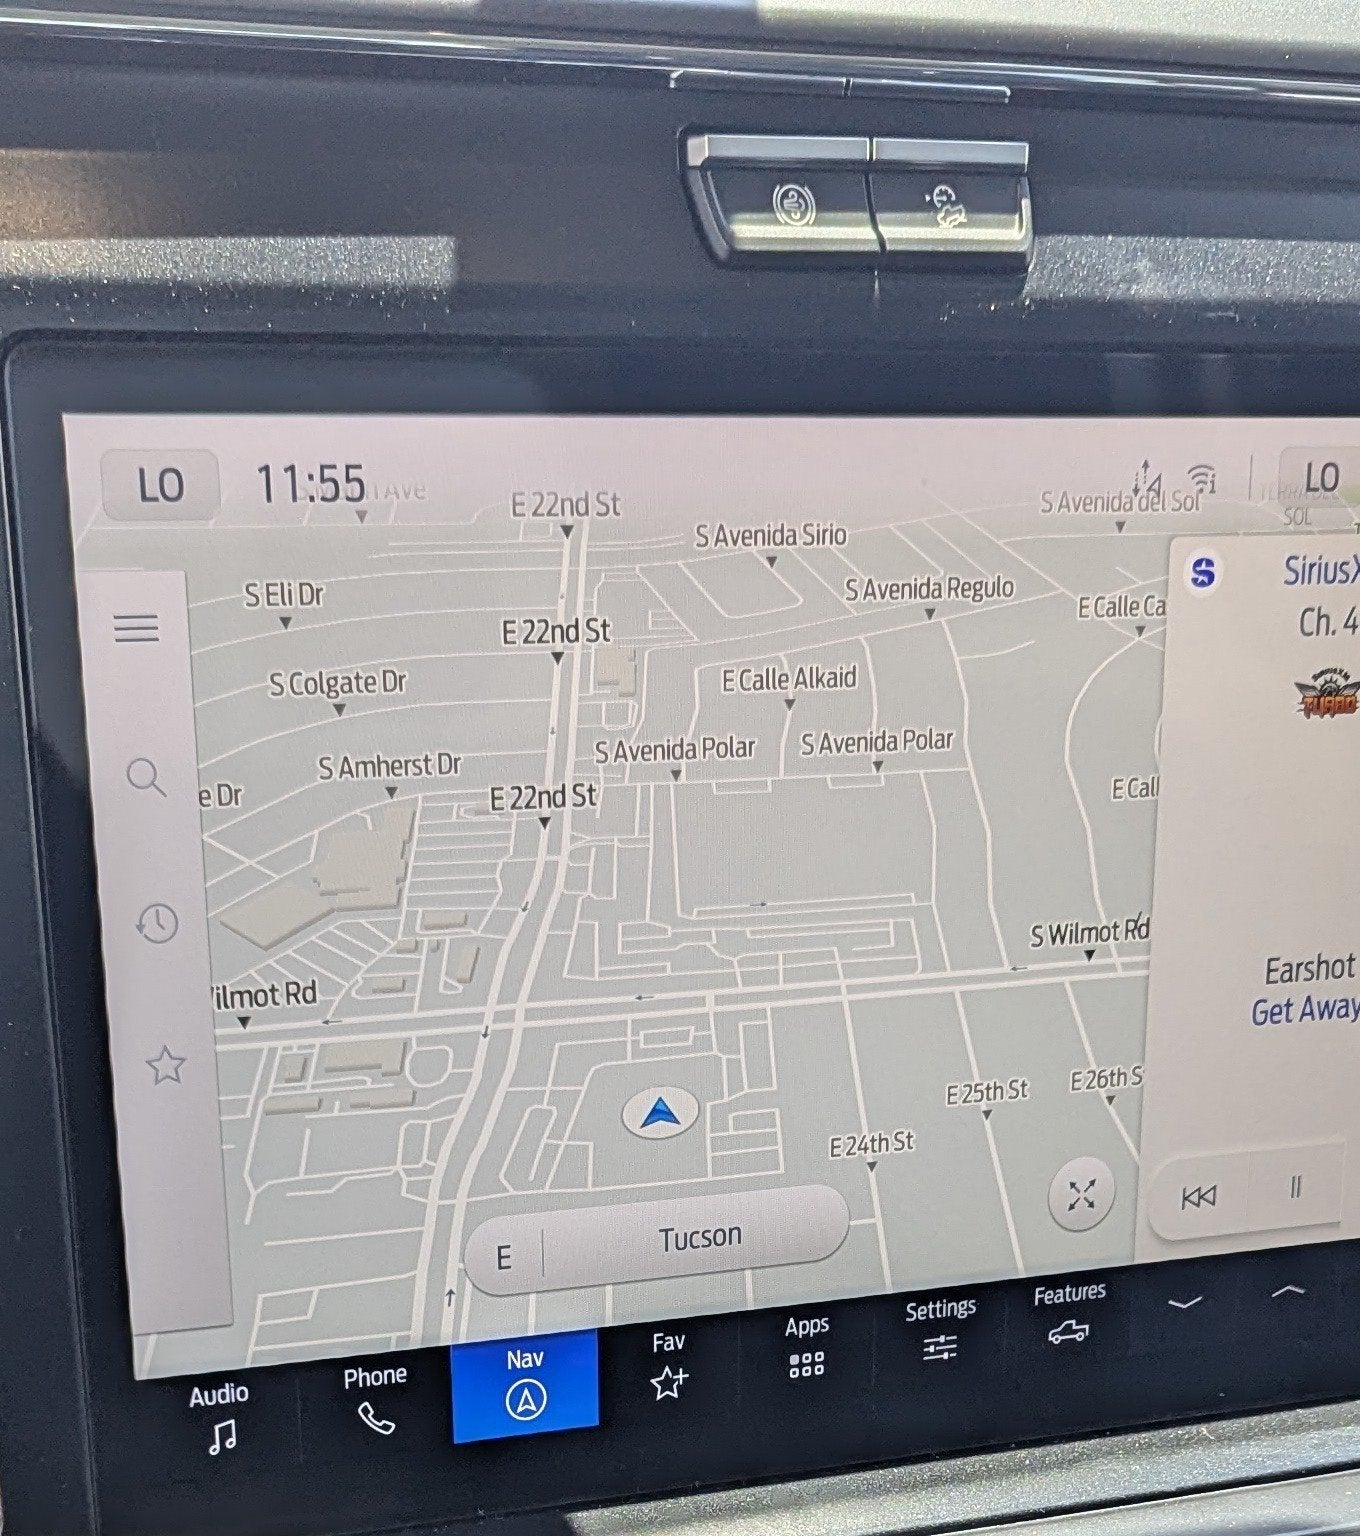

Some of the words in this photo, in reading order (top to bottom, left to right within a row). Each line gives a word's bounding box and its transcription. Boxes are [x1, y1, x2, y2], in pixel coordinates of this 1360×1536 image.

[138, 467, 185, 503] LO
[257, 463, 366, 504] 11:55
[1306, 462, 1340, 492] LO
[511, 492, 527, 517] E
[531, 489, 589, 517] 22nd
[594, 489, 621, 516] St
[1041, 491, 1054, 513] S
[1057, 490, 1133, 513] Avenida
[1139, 491, 1166, 512] del
[1172, 490, 1200, 512] Sol
[695, 524, 709, 548] S
[713, 524, 797, 547] Avenida
[801, 523, 847, 546] Sirio
[244, 584, 259, 607] S
[264, 582, 296, 607] Eli
[299, 583, 325, 606] Dr
[845, 579, 859, 602] S
[863, 577, 942, 601] Avenida
[947, 576, 1014, 602] Regulo
[1079, 597, 1090, 618] E
[1094, 595, 1140, 618] Calle
[503, 620, 517, 644] E
[520, 618, 579, 645] 22nd
[583, 618, 611, 643] St
[1300, 606, 1336, 637] Ch.
[269, 673, 284, 697] S
[289, 670, 377, 701] Colgate
[381, 670, 407, 693] Dr
[723, 669, 735, 692] E
[739, 668, 789, 691] Calle
[794, 666, 857, 689] Alkaid
[595, 740, 609, 764] S
[612, 737, 697, 763] Avenida
[701, 736, 755, 761] Polar
[801, 734, 814, 756] S
[818, 732, 899, 756] Avenida
[903, 730, 953, 753] Polar
[319, 757, 334, 781] S
[339, 753, 433, 780] Amherst
[436, 753, 463, 777] Dr
[217, 783, 242, 806] Dr
[490, 787, 504, 811] E
[507, 784, 566, 811] 22nd
[571, 783, 597, 808] St
[1112, 778, 1124, 799] E
[1030, 925, 1043, 948] S
[1048, 919, 1119, 946] Wilmot
[1124, 917, 1150, 942] Rd
[1265, 952, 1356, 986] Earshot
[210, 983, 280, 1010] ilmot
[285, 979, 318, 1005] Rd
[1252, 999, 1293, 1026] Get
[1071, 1071, 1082, 1091] E
[1086, 1067, 1128, 1089] 26th
[1131, 1065, 1145, 1085] S
[946, 1085, 958, 1106] E
[961, 1081, 1006, 1104] 25th
[1009, 1080, 1028, 1100] St
[830, 1136, 842, 1158] E
[845, 1133, 892, 1156] 24th
[894, 1131, 914, 1152] St
[659, 1224, 742, 1252] Tucson
[497, 1245, 512, 1271] E
[1034, 1282, 1106, 1306] Features
[905, 1298, 976, 1323] Settings
[785, 1316, 830, 1338] Apps
[652, 1332, 686, 1352] Fav
[507, 1348, 545, 1370] Nav
[343, 1363, 407, 1389] Phone
[189, 1382, 249, 1408] Audio
